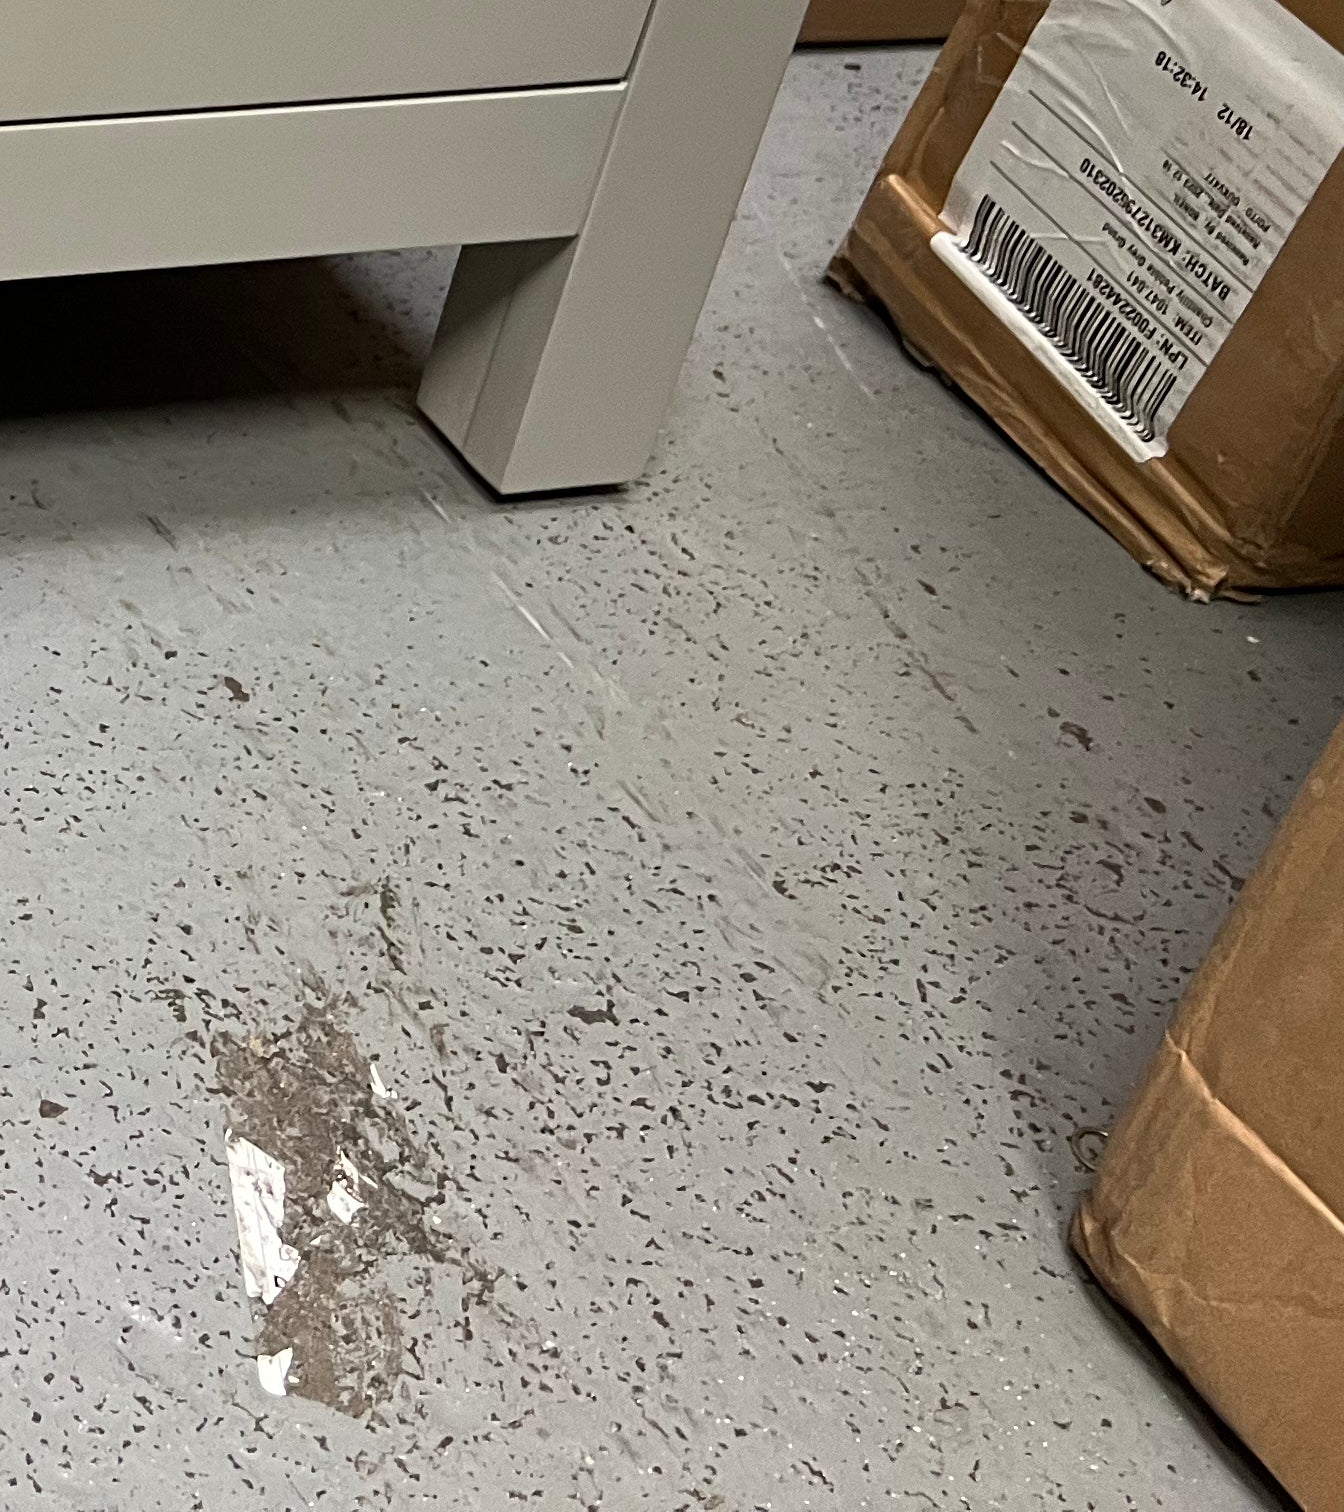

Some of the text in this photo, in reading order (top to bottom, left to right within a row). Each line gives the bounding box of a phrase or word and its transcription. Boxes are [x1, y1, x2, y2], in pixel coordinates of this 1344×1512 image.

[1154, 50, 1208, 101] 14:32:18
[1216, 102, 1252, 140] 18/12
[1181, 249, 1231, 301] BATCH:
[1086, 267, 1188, 371] LPN: F002244281
[1174, 313, 1203, 345] ITEM:
